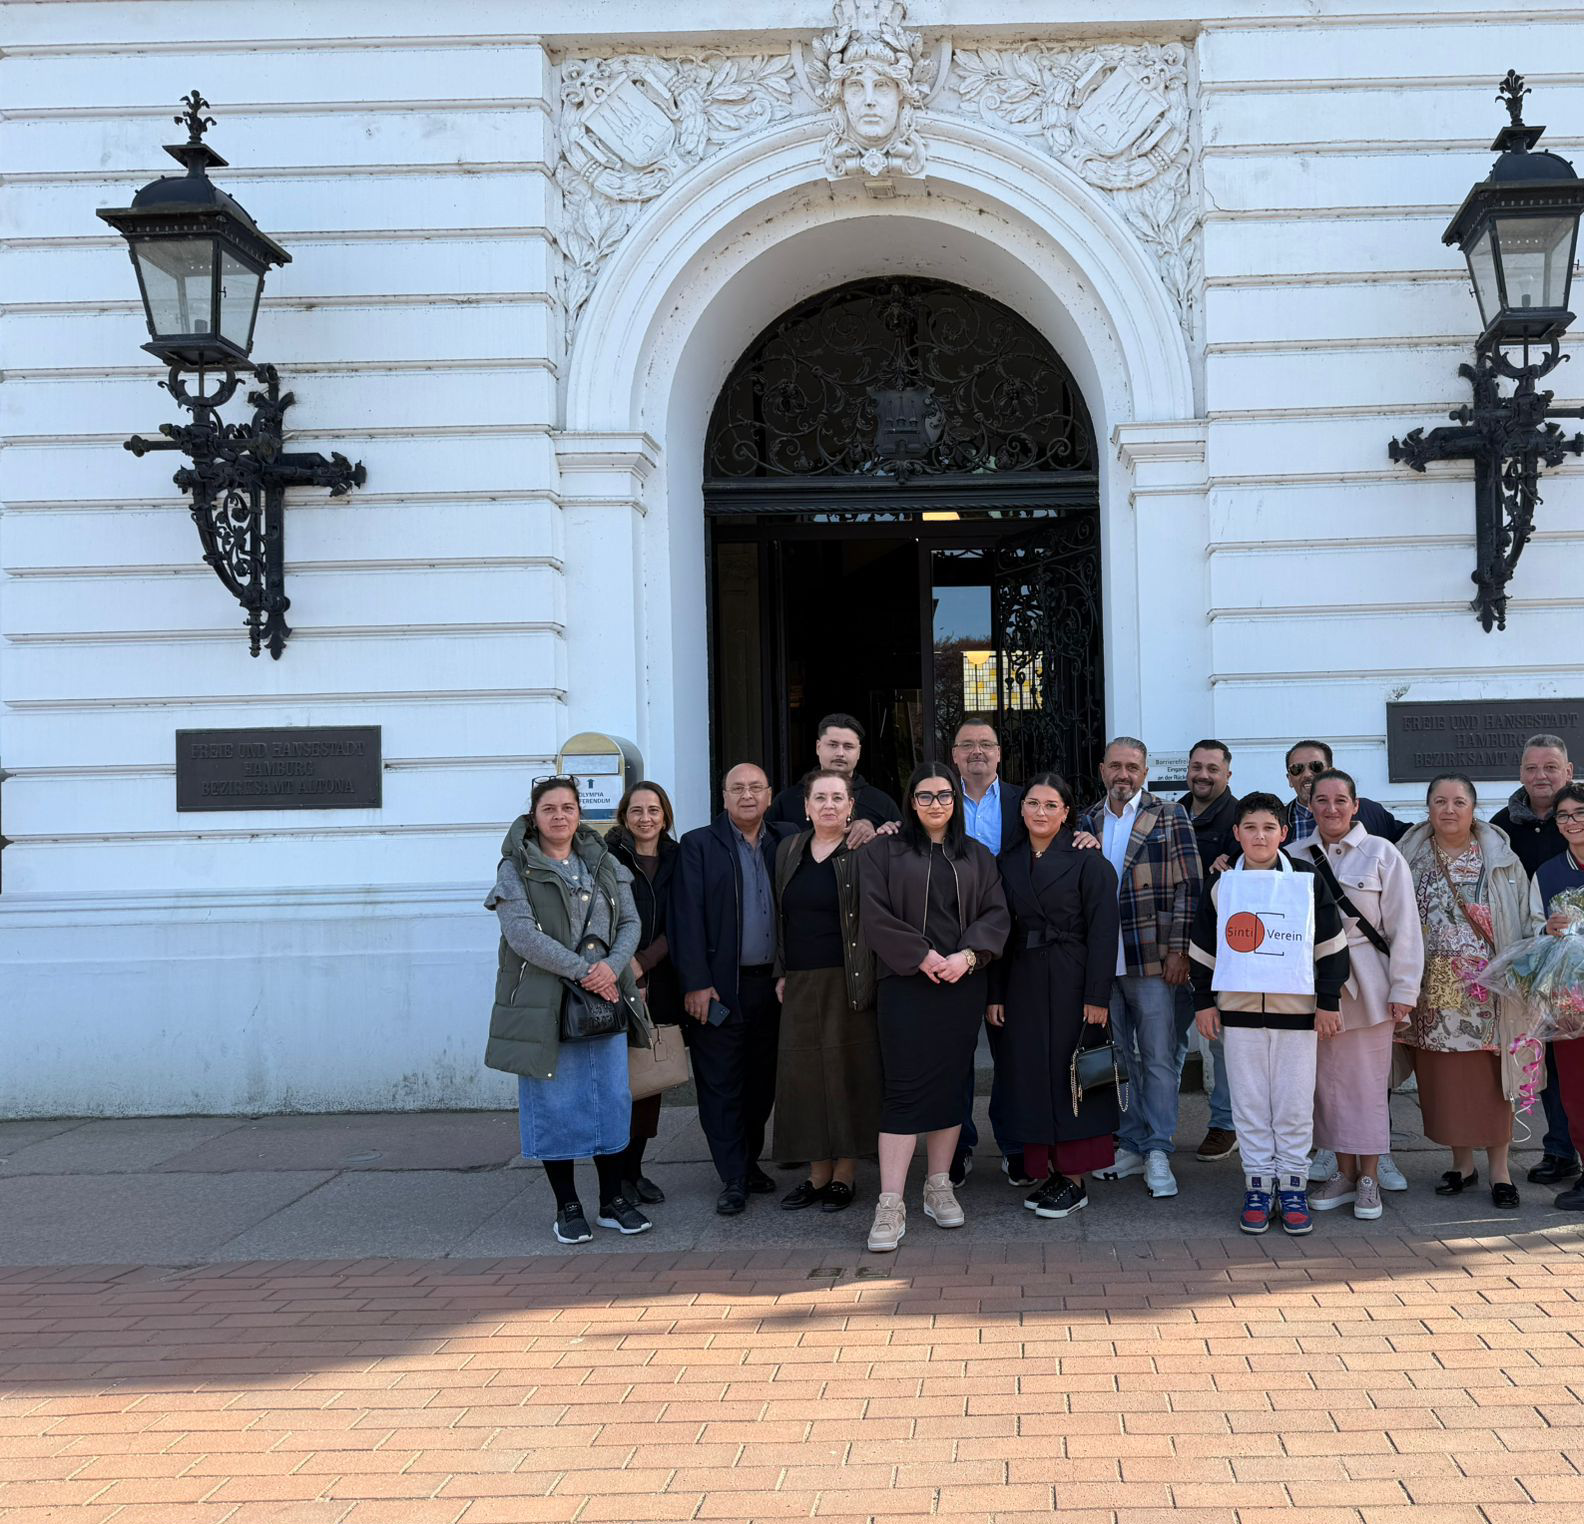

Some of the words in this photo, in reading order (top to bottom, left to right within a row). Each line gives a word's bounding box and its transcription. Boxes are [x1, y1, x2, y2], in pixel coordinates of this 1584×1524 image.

[1403, 714, 1445, 732] FREIE
[1450, 714, 1479, 731] UND
[1484, 712, 1579, 730] HANSESTADT
[1456, 732, 1526, 749] HAMBURG
[1413, 751, 1510, 768] BEZIRKSAMT
[1227, 927, 1254, 937] Sinti
[1266, 928, 1302, 941] Verein
